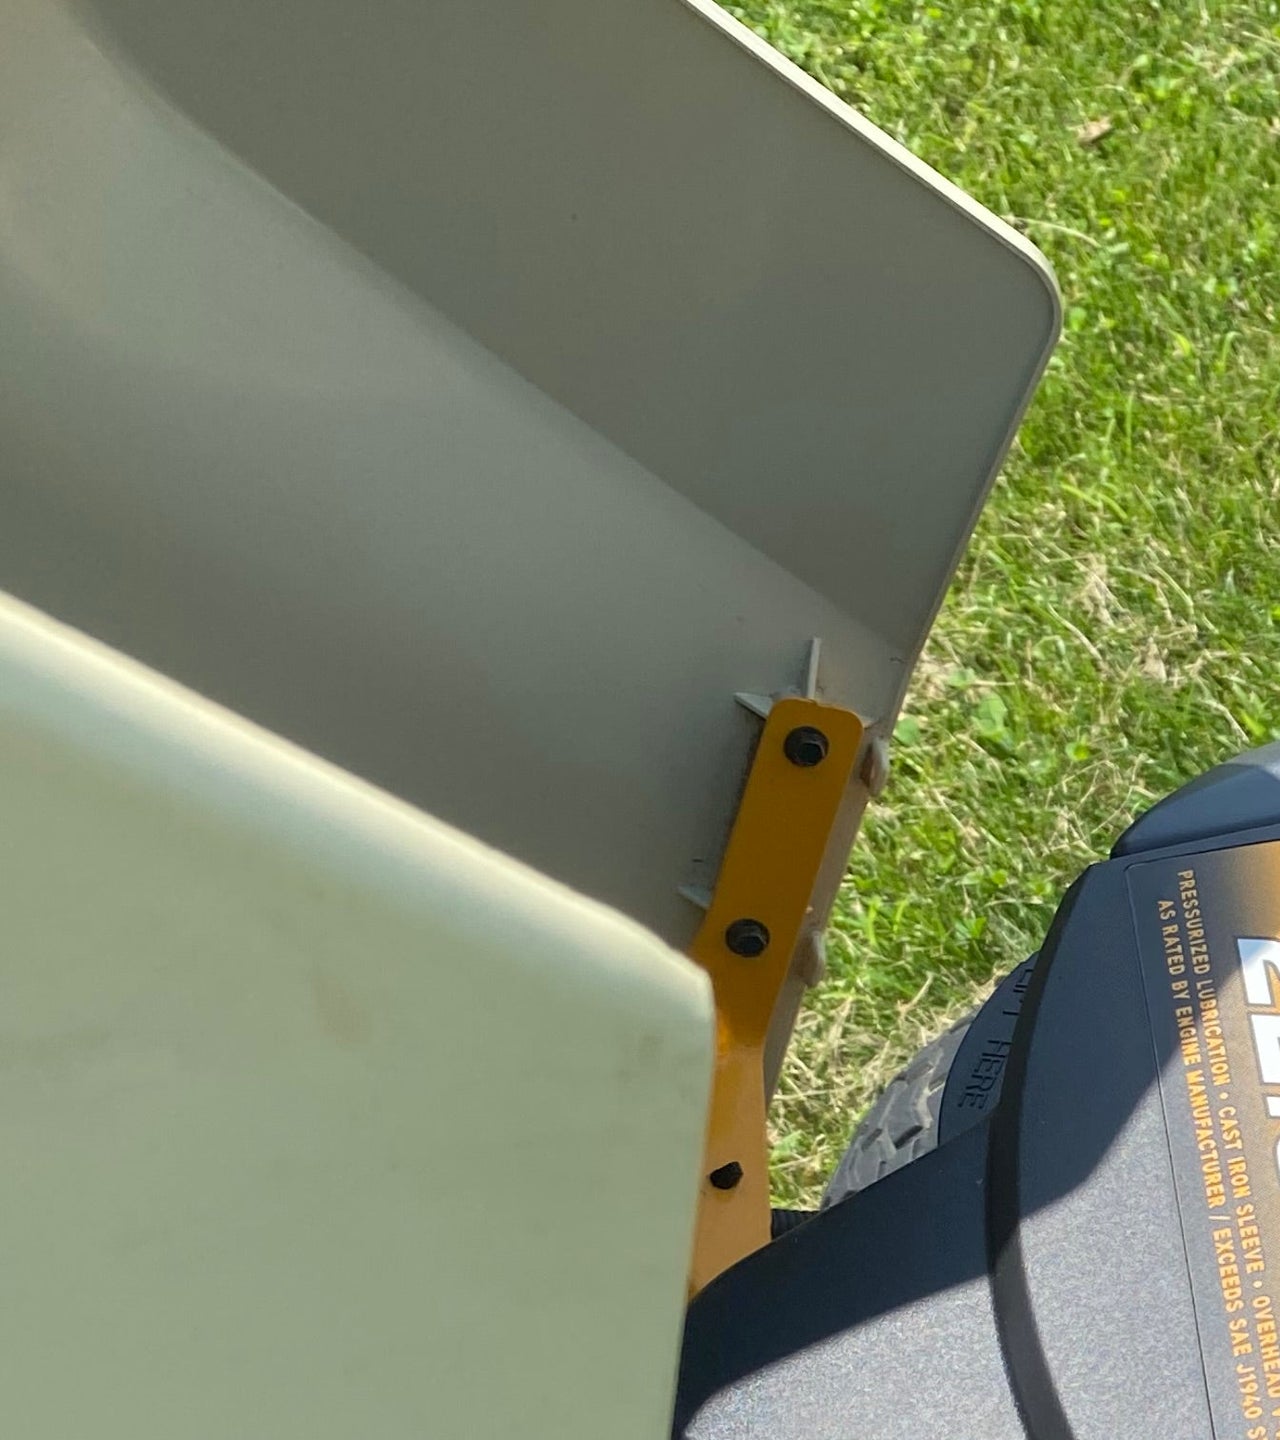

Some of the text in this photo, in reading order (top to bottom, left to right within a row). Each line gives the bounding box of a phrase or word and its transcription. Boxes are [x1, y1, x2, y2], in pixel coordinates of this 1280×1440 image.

[1157, 899, 1176, 921] AS
[1177, 868, 1212, 976] PRESSURIZED
[1161, 923, 1186, 977] RATED
[1170, 978, 1192, 1001] BY
[1174, 1004, 1203, 1068] ENGINE
[1195, 978, 1232, 1087] LUBRICATION
[957, 1038, 1013, 1110] HERE
[1185, 1069, 1227, 1210] MANUFACTURER
[1217, 1105, 1244, 1151] CAST
[1226, 1155, 1252, 1200] IRON
[1235, 1202, 1266, 1275] SLEEVE
[1211, 1227, 1245, 1314] EXCEEDS
[1228, 1317, 1254, 1358] SAE
[1235, 1363, 1264, 1420] J1940
